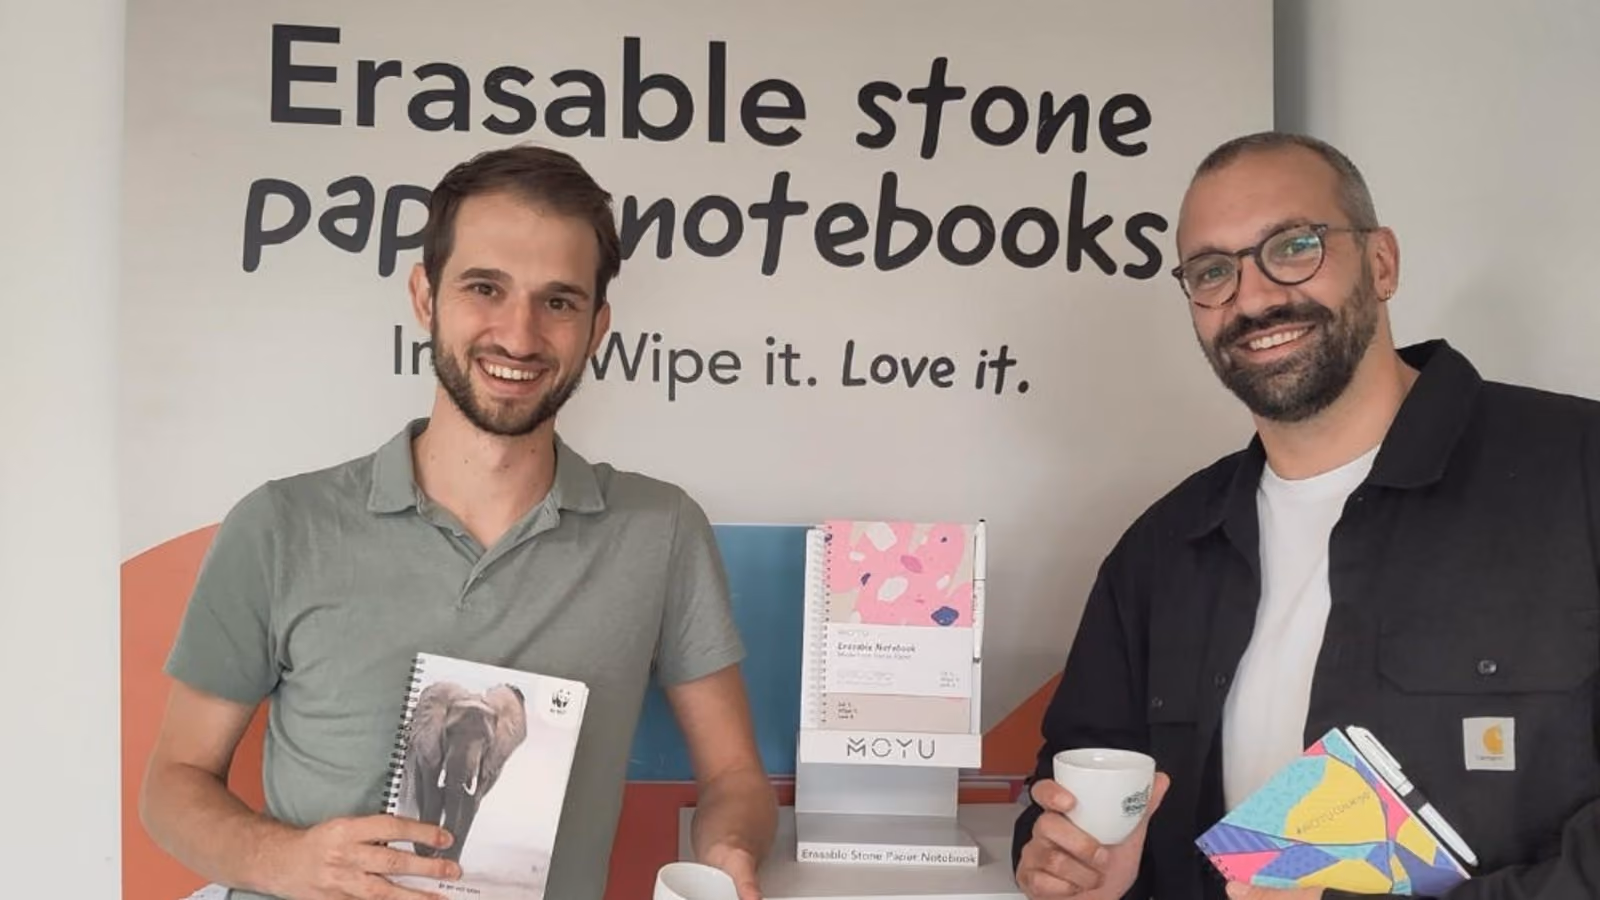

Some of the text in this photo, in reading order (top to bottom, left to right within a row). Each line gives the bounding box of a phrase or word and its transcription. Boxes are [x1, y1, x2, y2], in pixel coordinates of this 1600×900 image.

[271, 23, 1152, 159] Erasable stone
[242, 171, 1169, 279] pap notebooks
[394, 324, 1029, 401] In Wipe it. Love it.
[837, 641, 916, 653] Erasable Notebook
[846, 737, 936, 760] MOYU
[801, 848, 976, 864] Erasable Stone Paper Notebook
